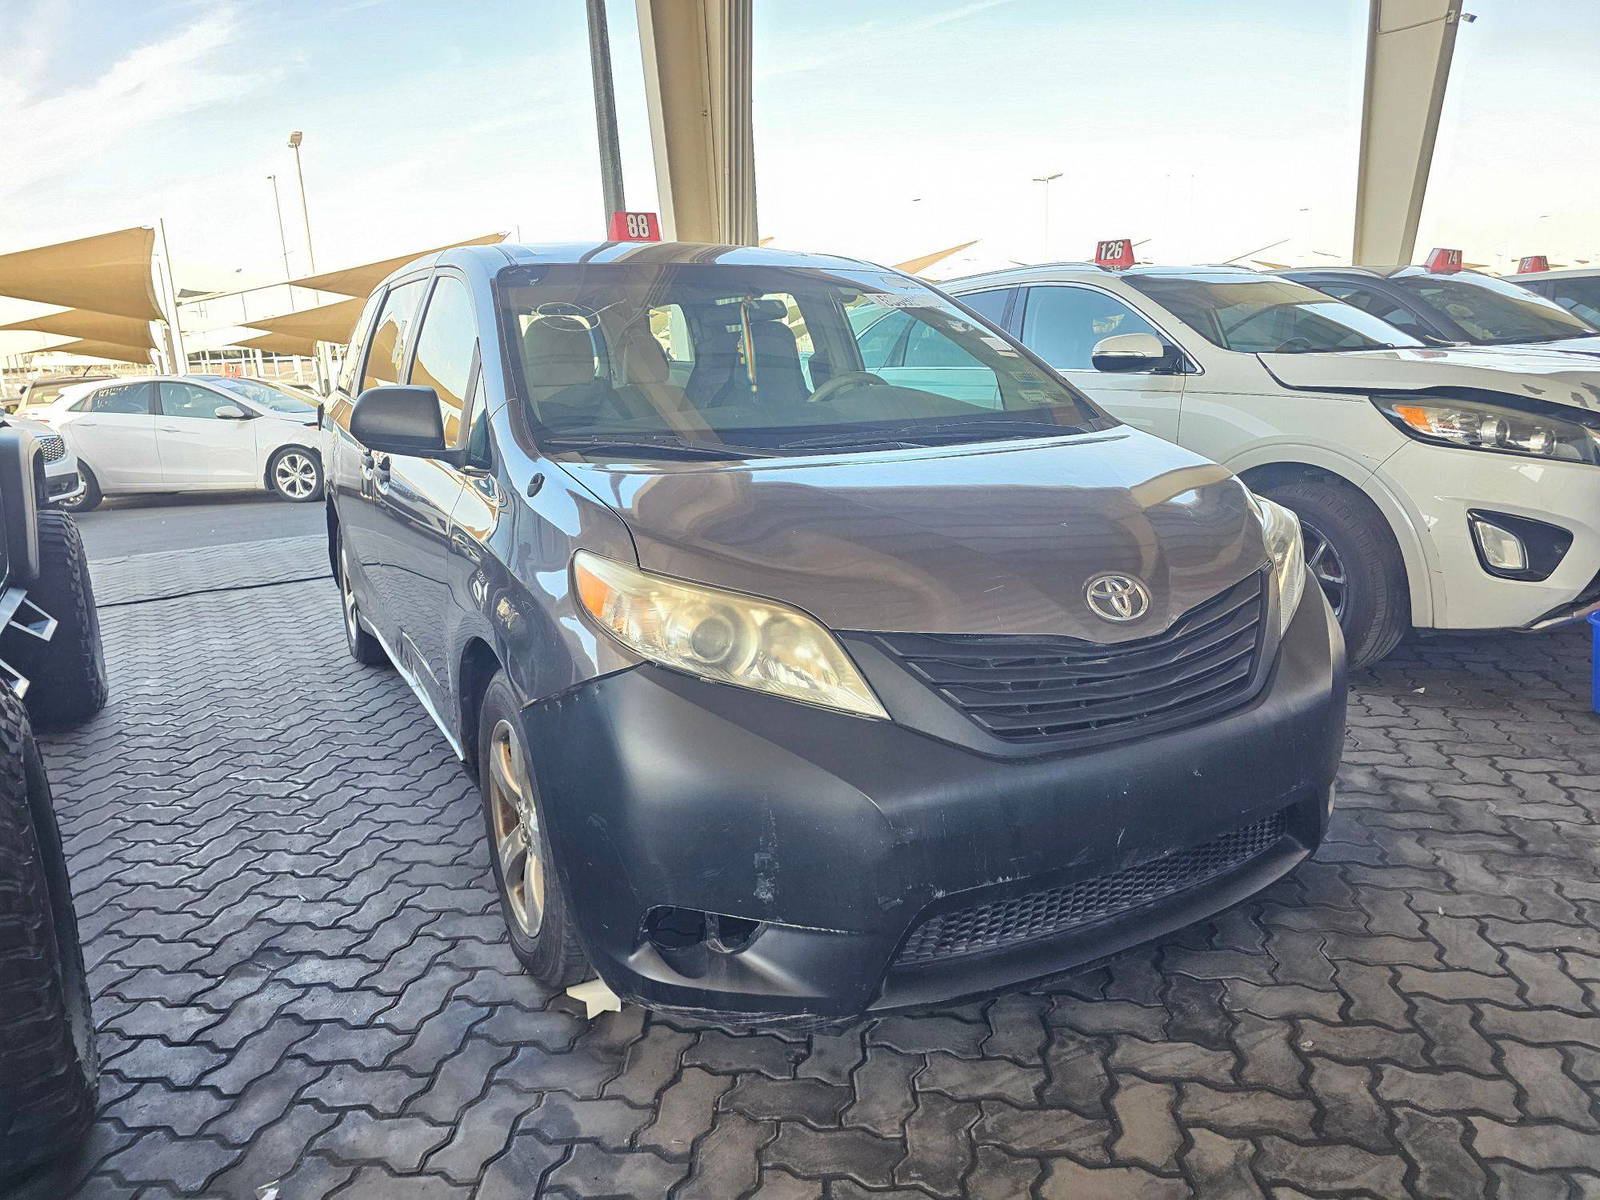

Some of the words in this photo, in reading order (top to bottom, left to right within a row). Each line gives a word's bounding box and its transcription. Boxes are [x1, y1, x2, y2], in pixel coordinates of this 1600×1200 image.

[626, 214, 650, 238] 88
[1100, 241, 1124, 260] 126
[1447, 250, 1459, 265] 74
